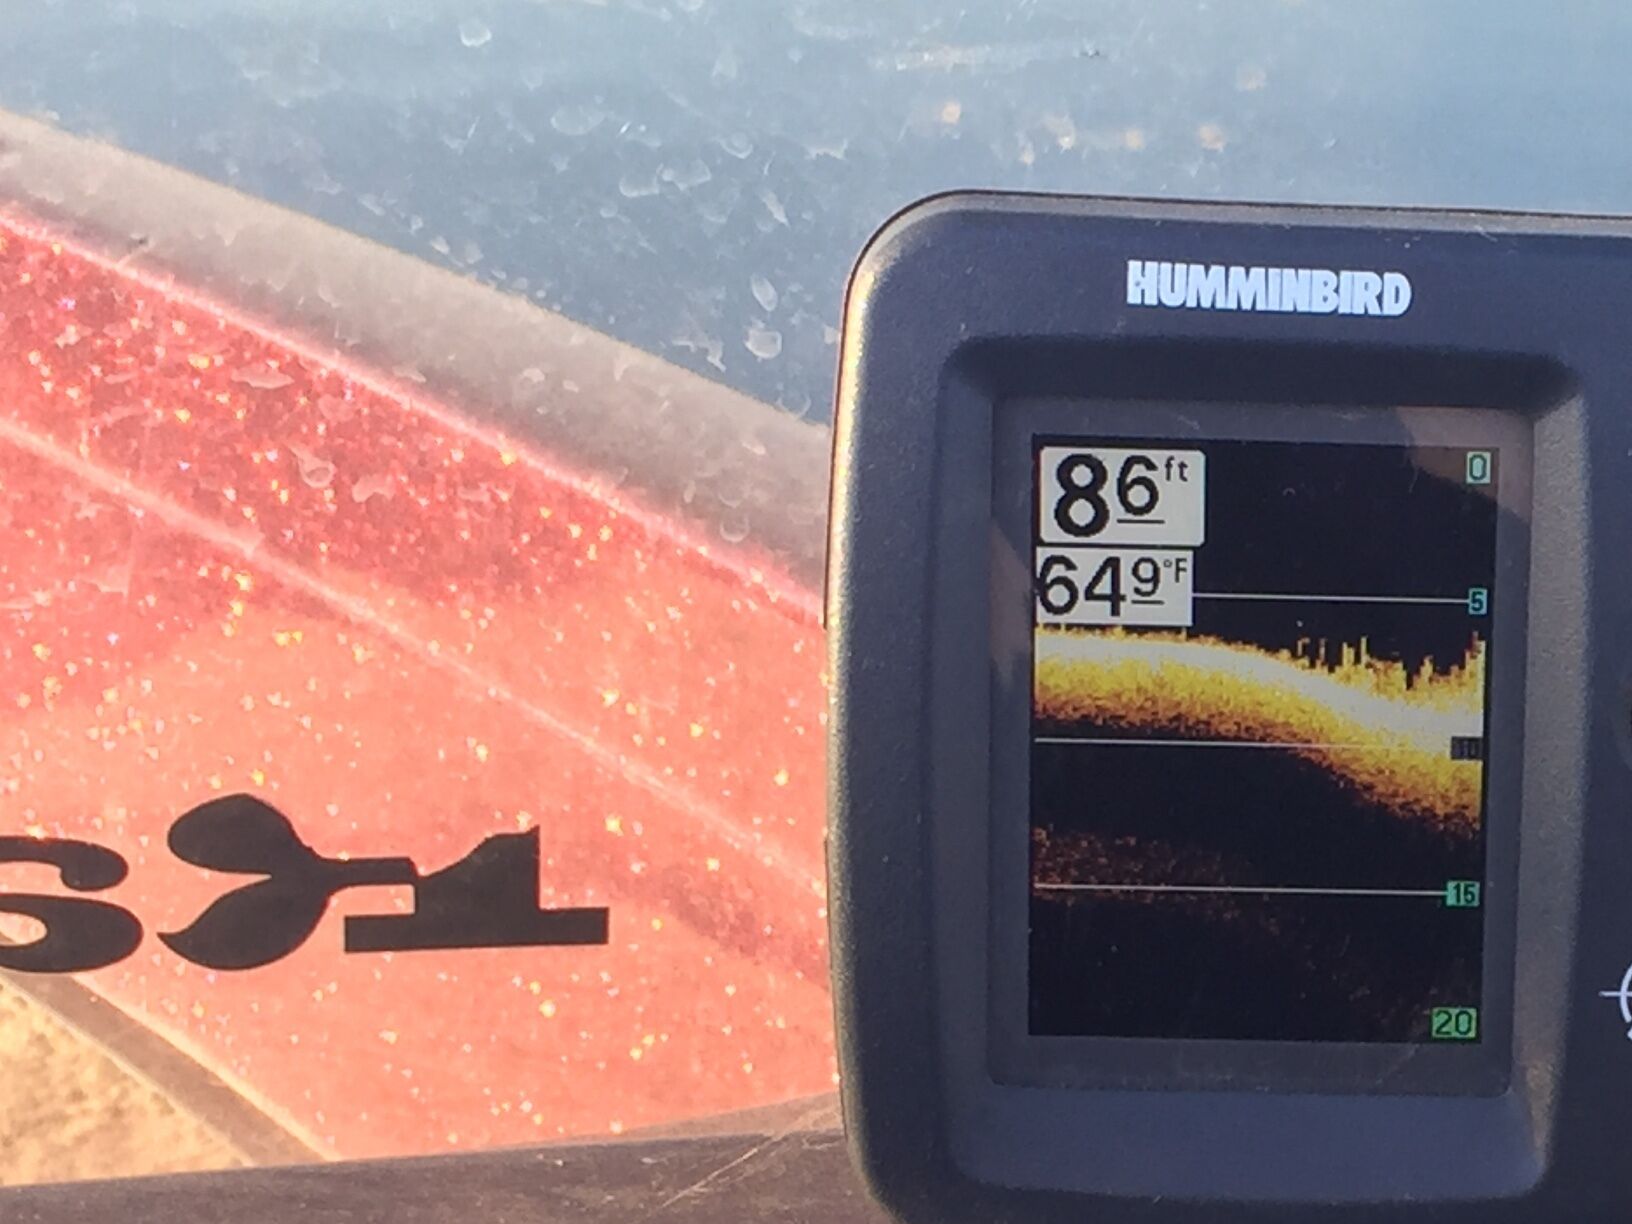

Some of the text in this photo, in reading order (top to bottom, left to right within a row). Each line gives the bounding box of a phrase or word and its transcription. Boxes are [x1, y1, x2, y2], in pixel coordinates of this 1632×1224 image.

[1127, 260, 1412, 316] HUMMINBIRD
[1471, 591, 1485, 613] 5
[1453, 883, 1477, 904] 15
[1435, 1010, 1474, 1037] 20
